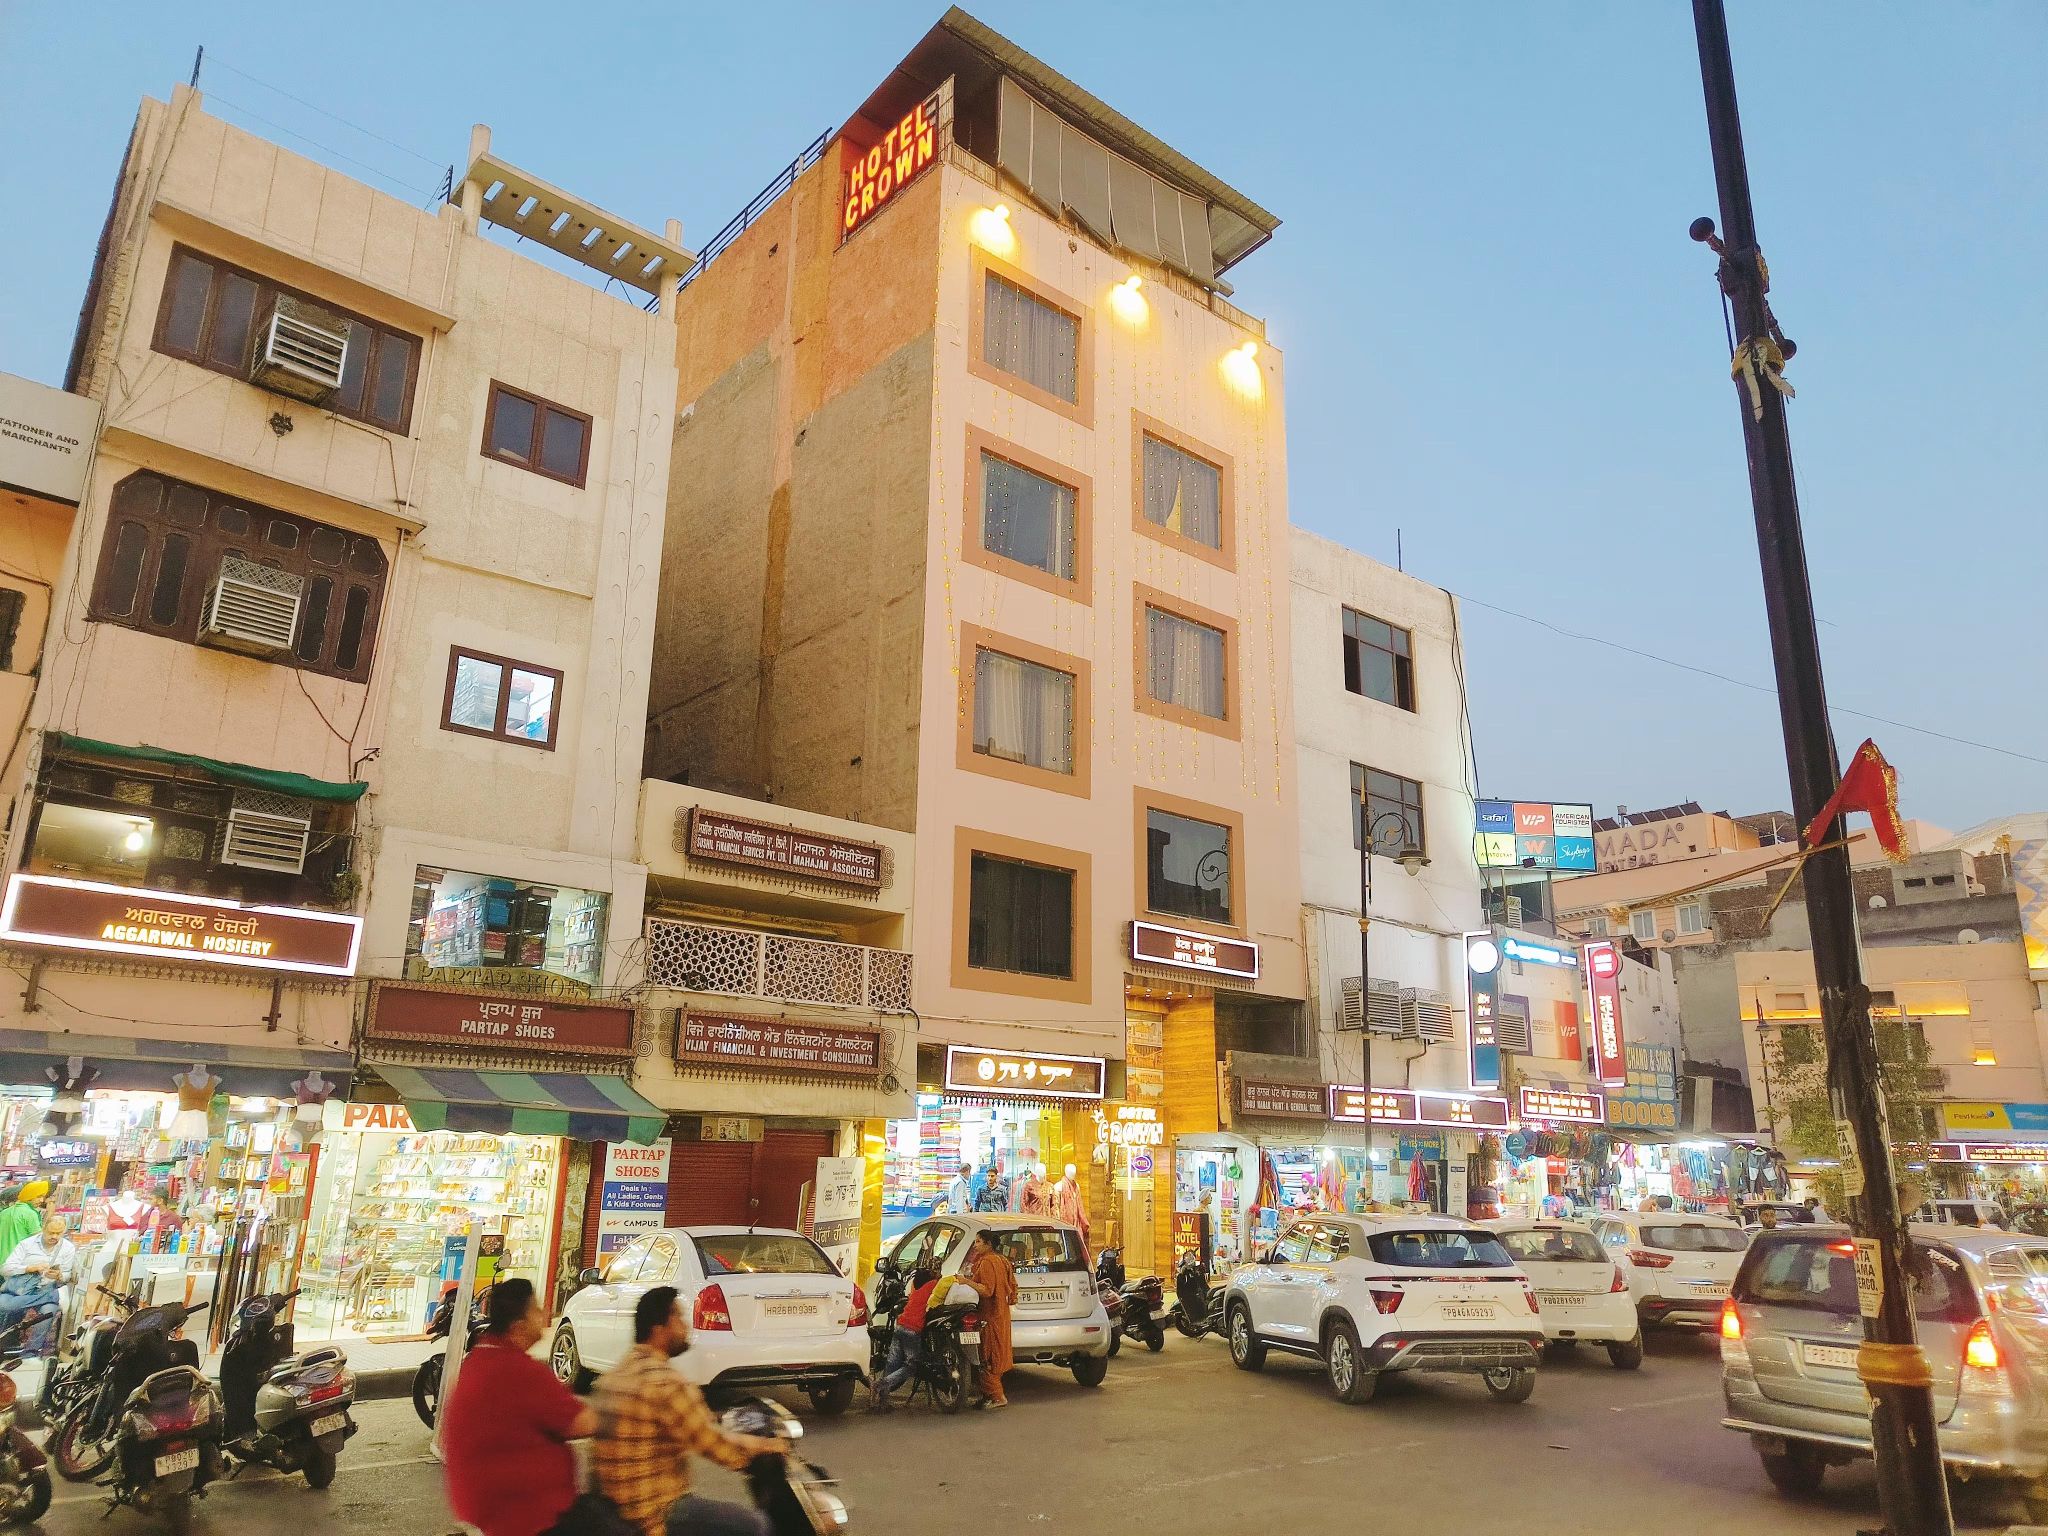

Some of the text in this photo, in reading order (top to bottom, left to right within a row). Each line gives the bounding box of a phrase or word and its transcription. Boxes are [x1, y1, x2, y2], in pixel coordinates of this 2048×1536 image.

[851, 105, 927, 195] HOTEL
[845, 128, 932, 227] CROWN
[1, 429, 71, 454] MARCHANTS
[56, 434, 79, 446] AND
[1482, 813, 1507, 822] safari
[1522, 814, 1545, 826] VIP
[715, 840, 741, 854] FINANCIAL
[743, 845, 765, 859] SERVICES
[794, 841, 826, 857] ਮਹਾਜਨ
[792, 853, 876, 879] MAHAJAN ASSOCIATES
[125, 907, 207, 930] ਅਗਰਵਾਲ
[102, 924, 272, 956] AGGARWAL HOSIERY
[418, 960, 512, 990] PARTAP
[480, 1002, 516, 1020] ਪ੍ਰਤਾਪ
[461, 1019, 555, 1040] PARTAP SHOES
[686, 1020, 704, 1037] ਵਿਜੇ
[1561, 1025, 1577, 1037] VIP
[685, 1039, 874, 1066] VIJAY FINANCIAL & INVESTMENT CONSULTANTS
[343, 1104, 410, 1129] PAR
[1117, 1106, 1157, 1121] HOTEL
[1608, 1100, 1676, 1127] BOOKS
[1098, 1120, 1164, 1145] CROWN
[49, 1155, 90, 1164] MISS ADS
[613, 1148, 665, 1160] PARTAP
[616, 1166, 660, 1177] SHOES
[1174, 1231, 1200, 1244] HOTEL
